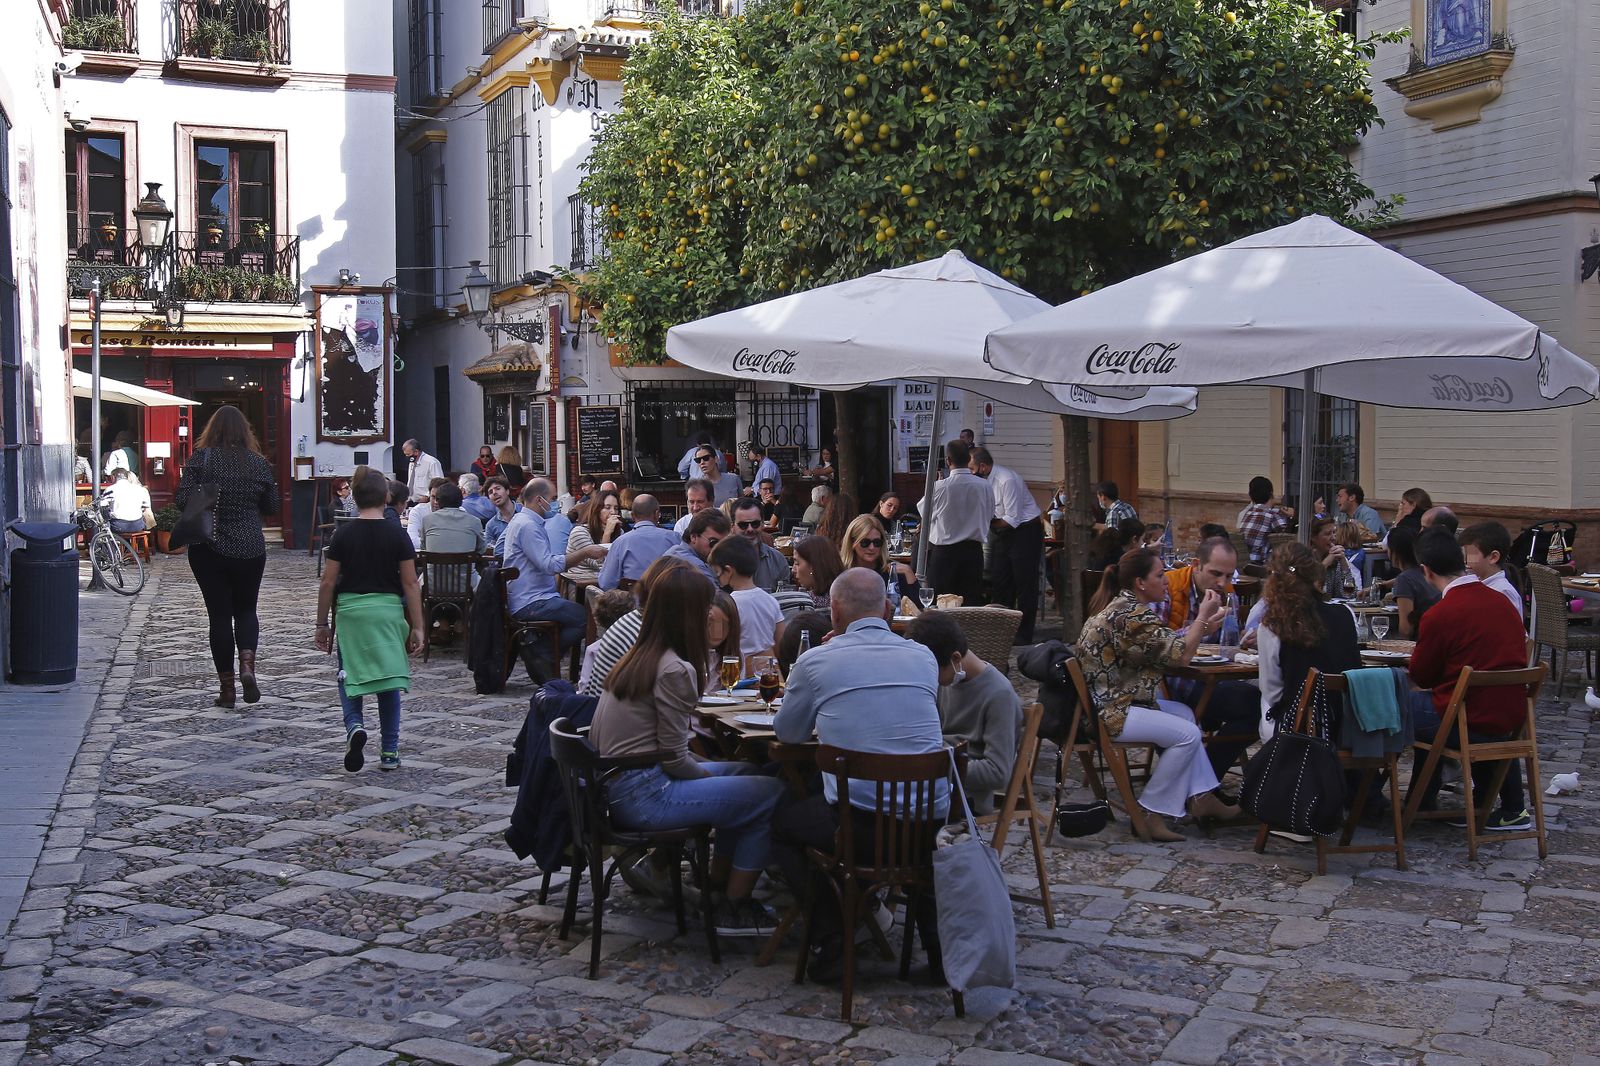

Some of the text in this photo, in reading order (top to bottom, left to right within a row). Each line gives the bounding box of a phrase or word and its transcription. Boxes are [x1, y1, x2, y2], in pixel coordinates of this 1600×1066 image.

[139, 334, 216, 347] Román
[904, 383, 932, 395] DEL
[904, 400, 961, 411] LAUEL
